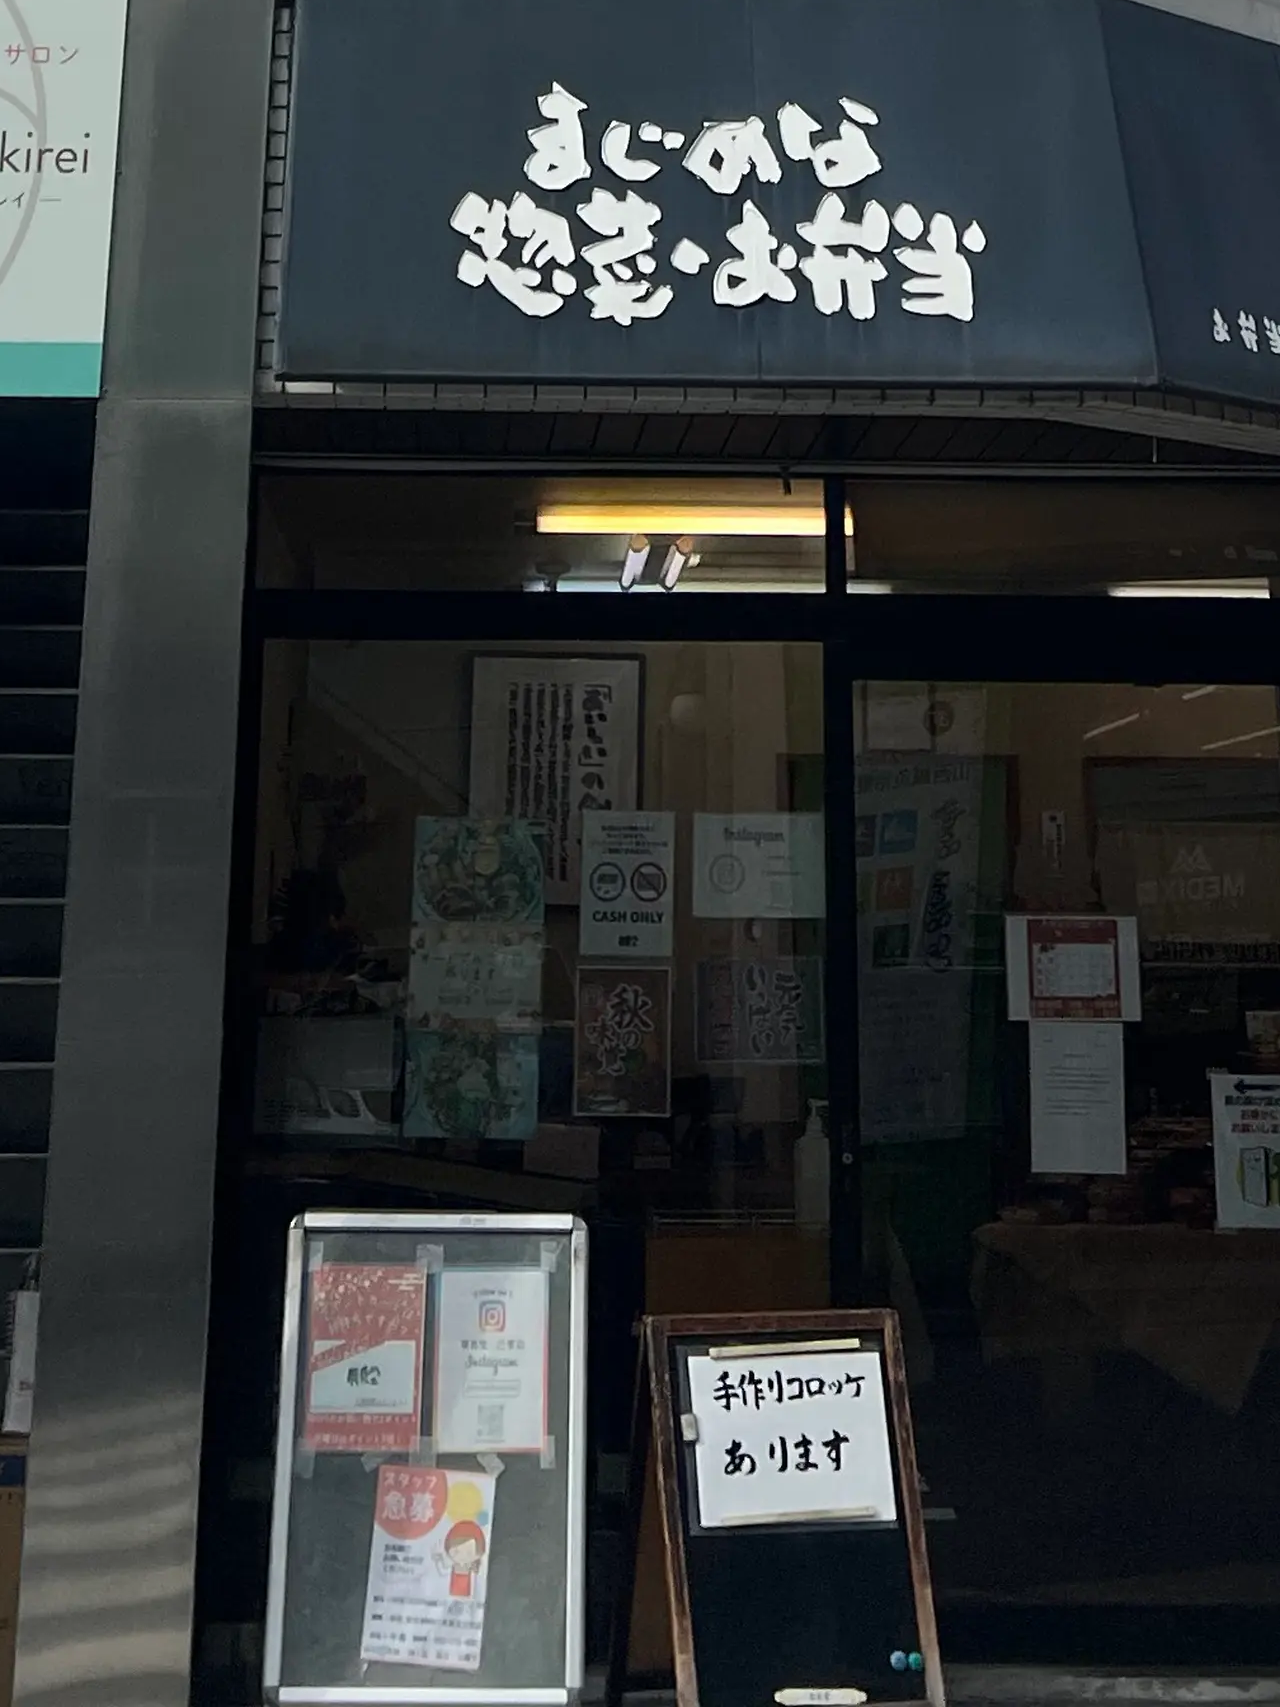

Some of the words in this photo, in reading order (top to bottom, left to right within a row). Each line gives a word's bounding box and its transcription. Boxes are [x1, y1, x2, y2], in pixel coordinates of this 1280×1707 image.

[523, 80, 884, 196] まじめな
[449, 187, 988, 328] 惣菜・お弁当
[592, 910, 628, 925] CASH
[631, 910, 664, 925] ONLY
[712, 1369, 866, 1412] 手作りコロッケ
[723, 1428, 851, 1476] あります
[383, 1471, 438, 1490] スタッフ
[381, 1490, 437, 1524] 急募
